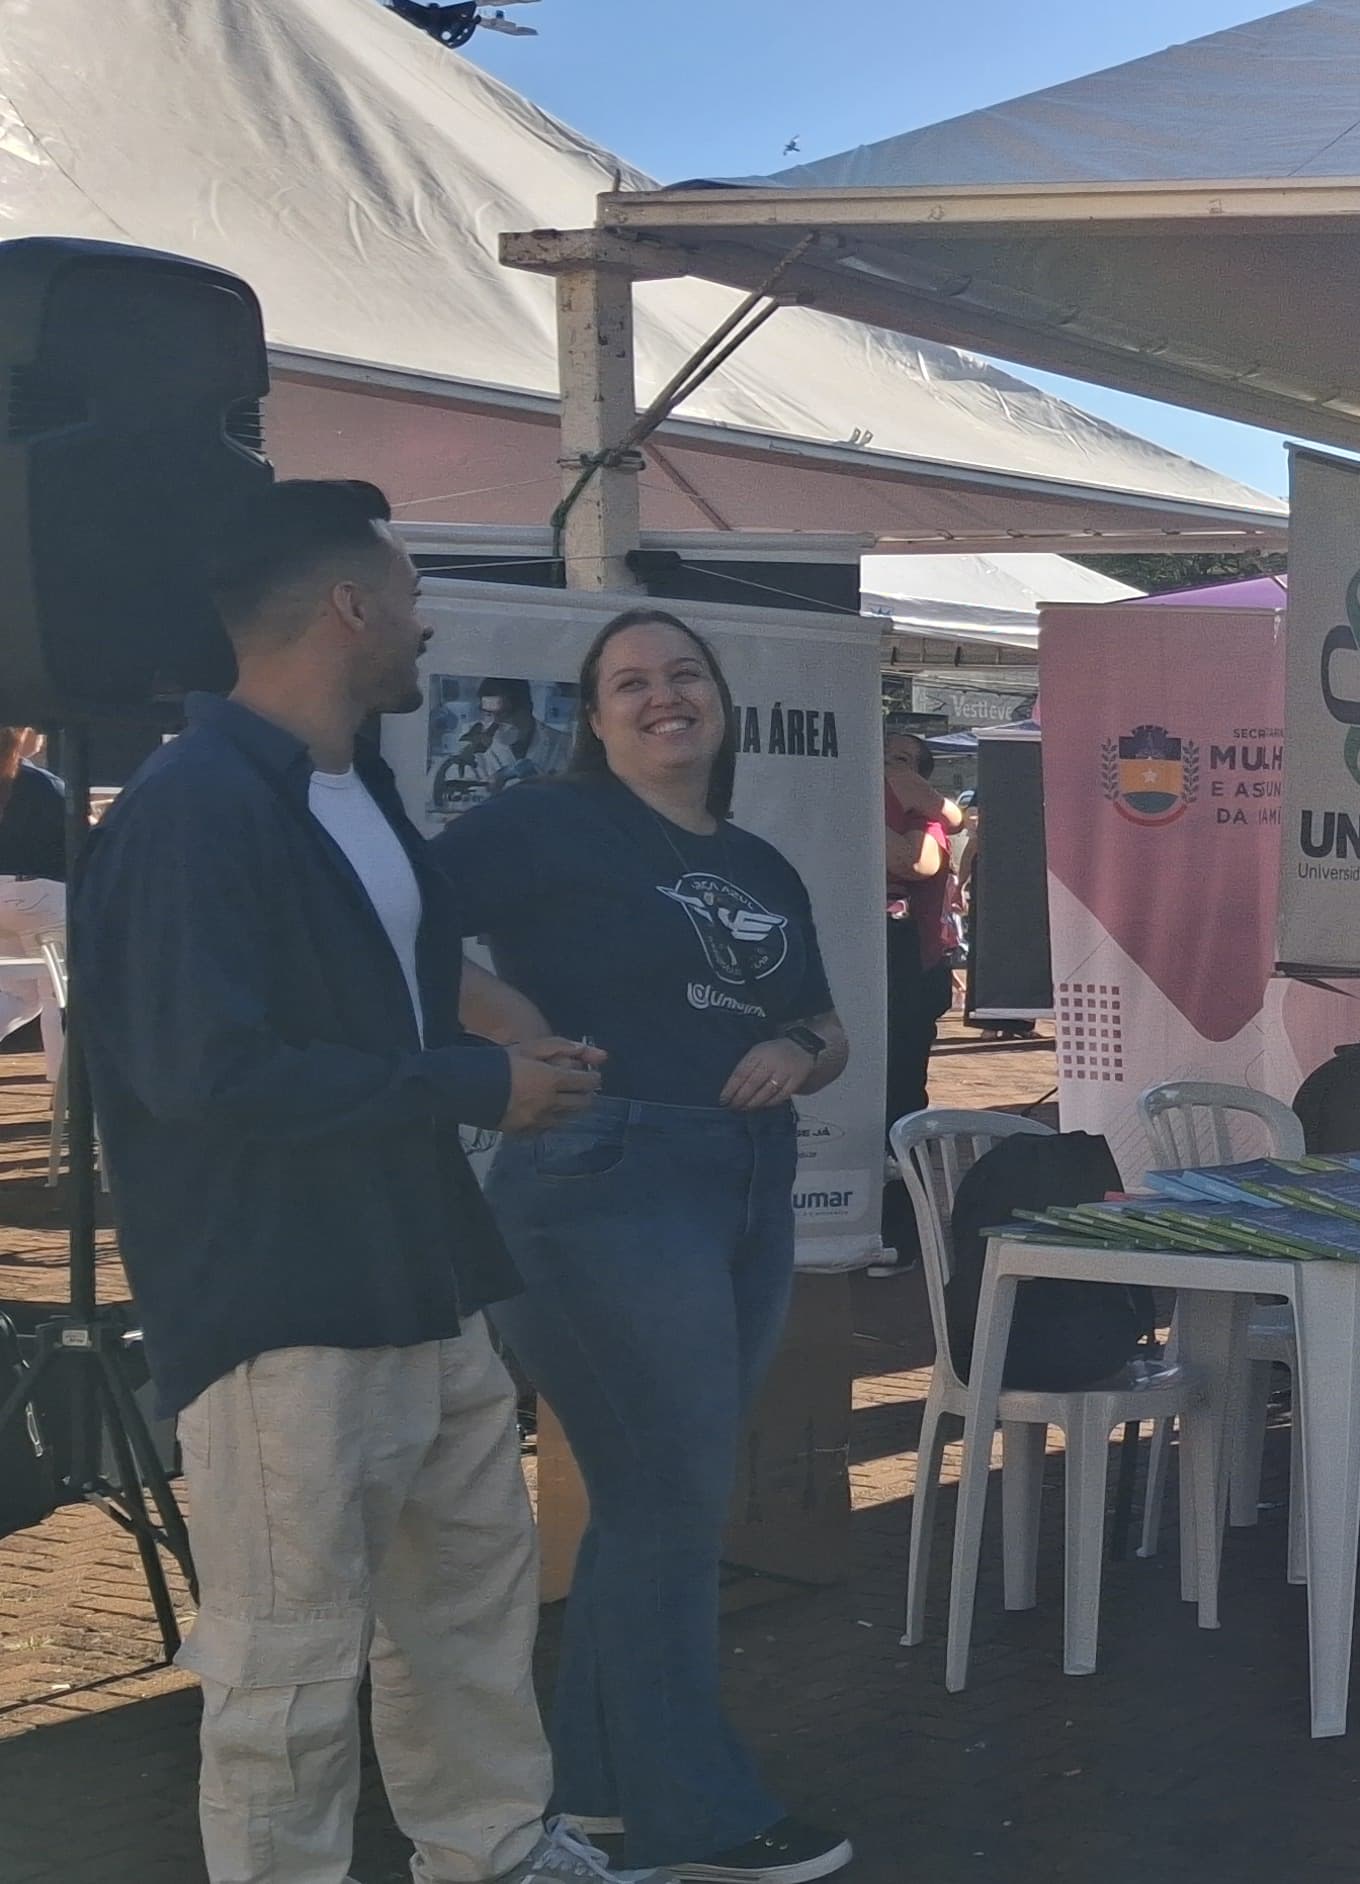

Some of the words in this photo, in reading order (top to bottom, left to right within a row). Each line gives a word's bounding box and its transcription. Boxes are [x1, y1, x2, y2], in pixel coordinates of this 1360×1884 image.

[768, 701, 838, 758] ÁREA
[1211, 781, 1224, 796] E
[1216, 807, 1248, 825] DA
